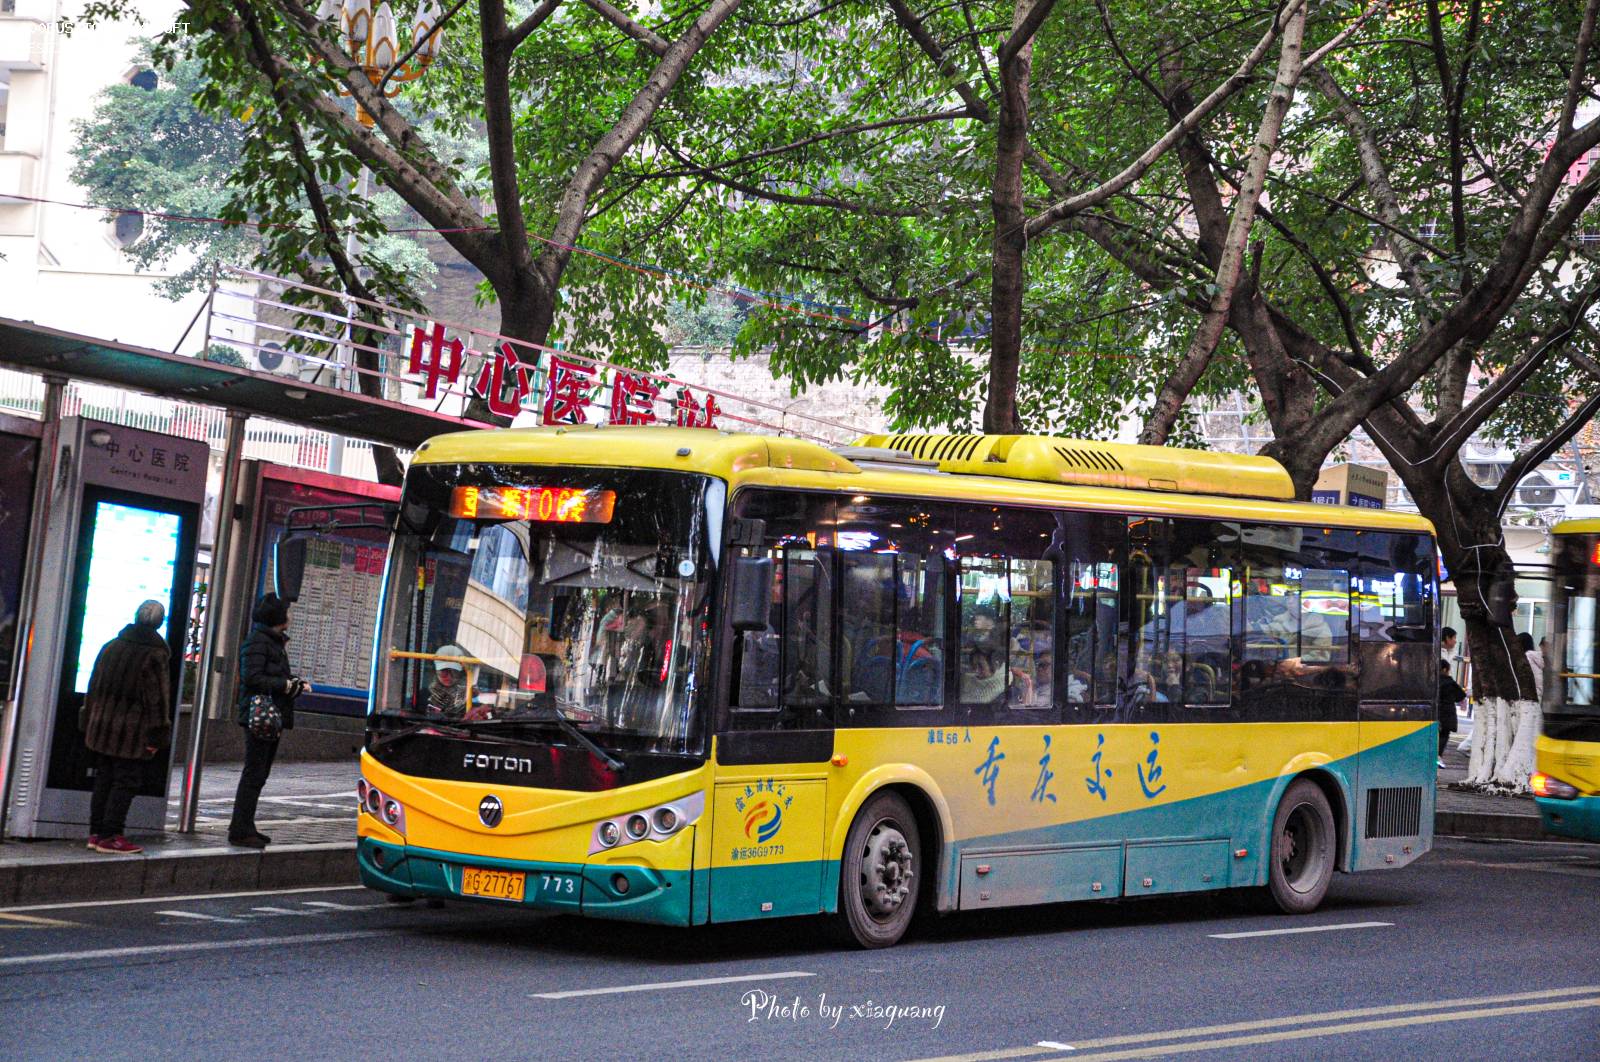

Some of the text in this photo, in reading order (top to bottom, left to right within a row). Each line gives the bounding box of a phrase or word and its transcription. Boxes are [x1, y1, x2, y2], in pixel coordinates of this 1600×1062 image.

[106, 440, 190, 472] 中心医院
[463, 752, 533, 774] FOTON
[542, 875, 575, 894] 773
